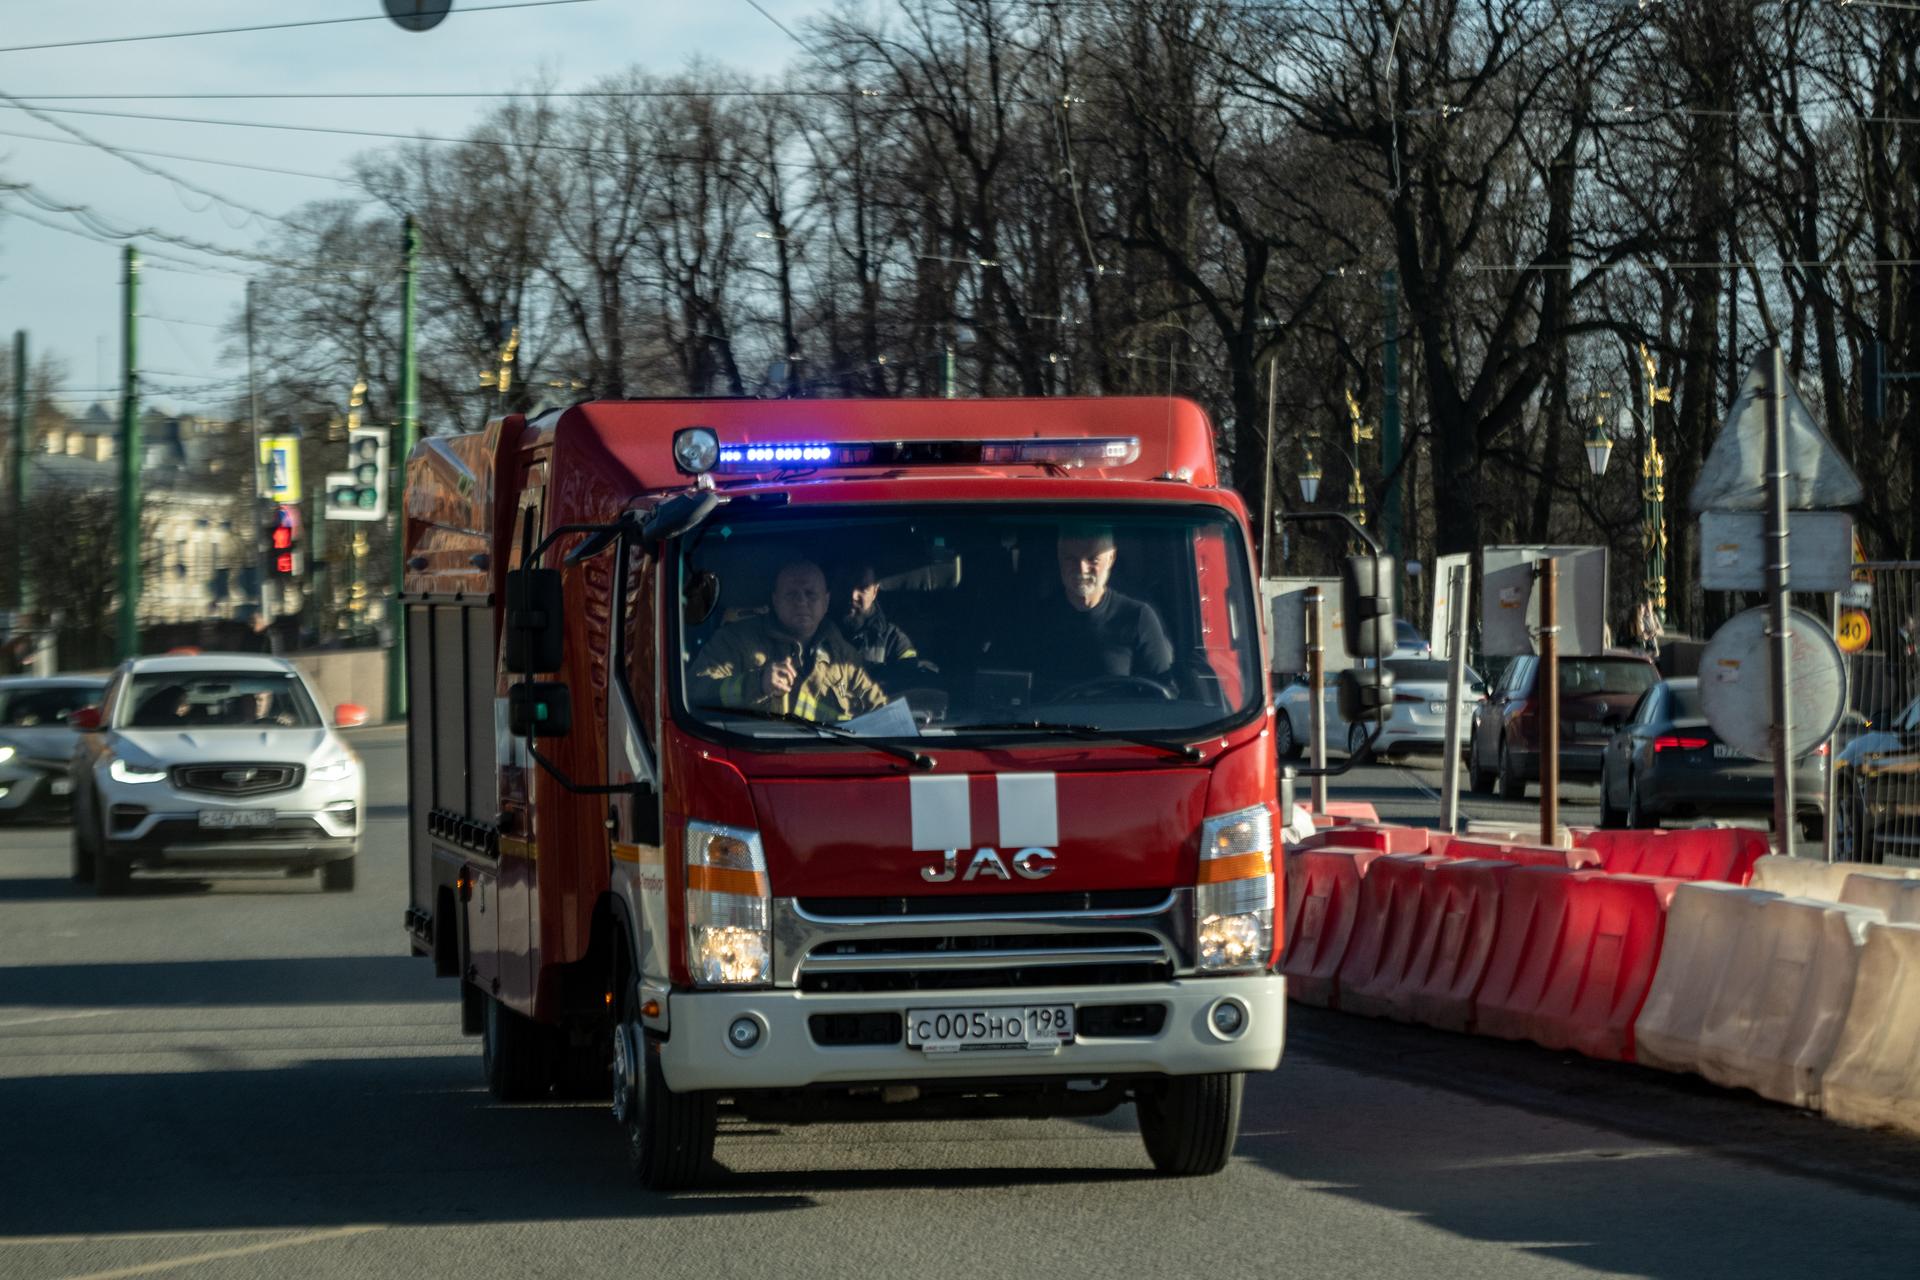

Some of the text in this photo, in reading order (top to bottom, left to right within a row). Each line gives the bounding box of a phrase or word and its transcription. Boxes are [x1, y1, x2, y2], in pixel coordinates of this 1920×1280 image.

[1840, 622, 1862, 641] 40
[920, 846, 1057, 882] JAC
[1028, 1009, 1067, 1030] 198
[1037, 1030, 1056, 1038] RUS
